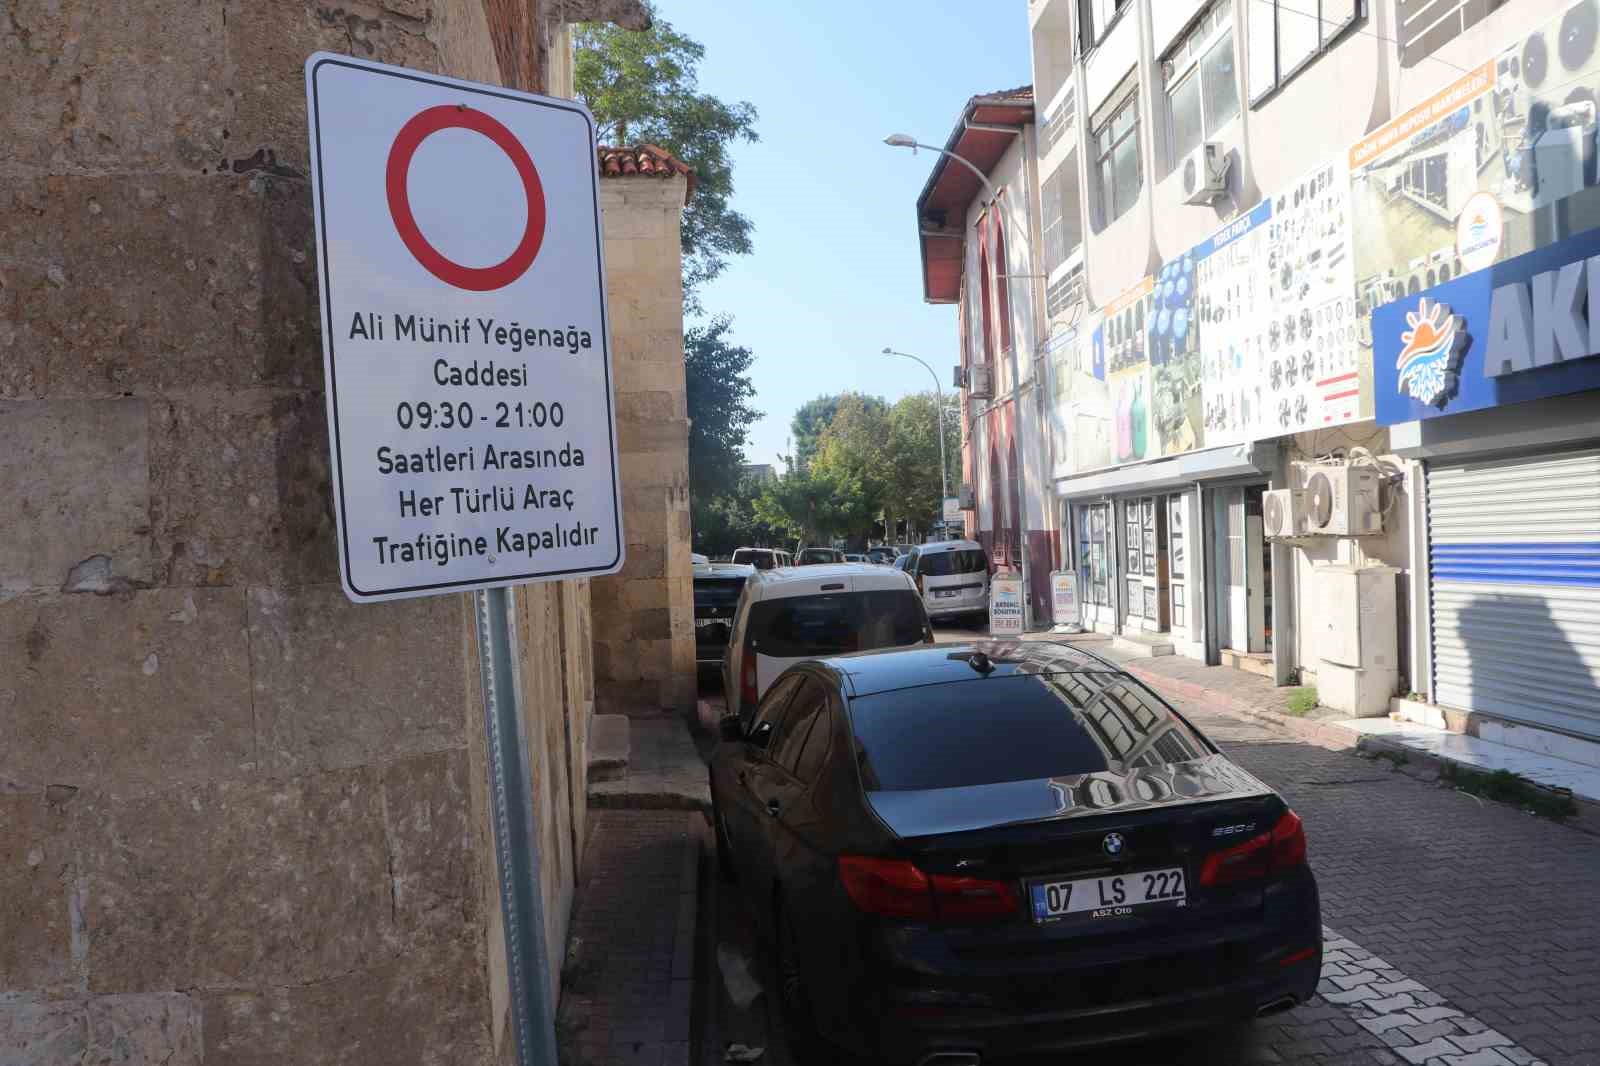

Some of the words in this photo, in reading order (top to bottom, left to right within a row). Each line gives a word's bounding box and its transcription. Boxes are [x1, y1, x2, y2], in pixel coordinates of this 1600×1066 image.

[349, 311, 384, 341] Ali
[394, 314, 470, 344] Münif
[477, 318, 592, 354] Yeğenağa
[433, 359, 528, 387] Caddesi
[397, 402, 473, 429] 09:30
[495, 401, 564, 428] 21:00
[377, 445, 475, 474] Saatleri
[482, 441, 585, 470] Arasında
[399, 490, 444, 518] Her
[450, 486, 514, 514] Türlü
[523, 484, 574, 511] Araç
[373, 533, 488, 566] Trafiğine
[496, 521, 599, 558] Kapalıdır
[1047, 884, 1072, 912] 07
[1098, 878, 1126, 906] LS
[1143, 870, 1184, 900] 222
